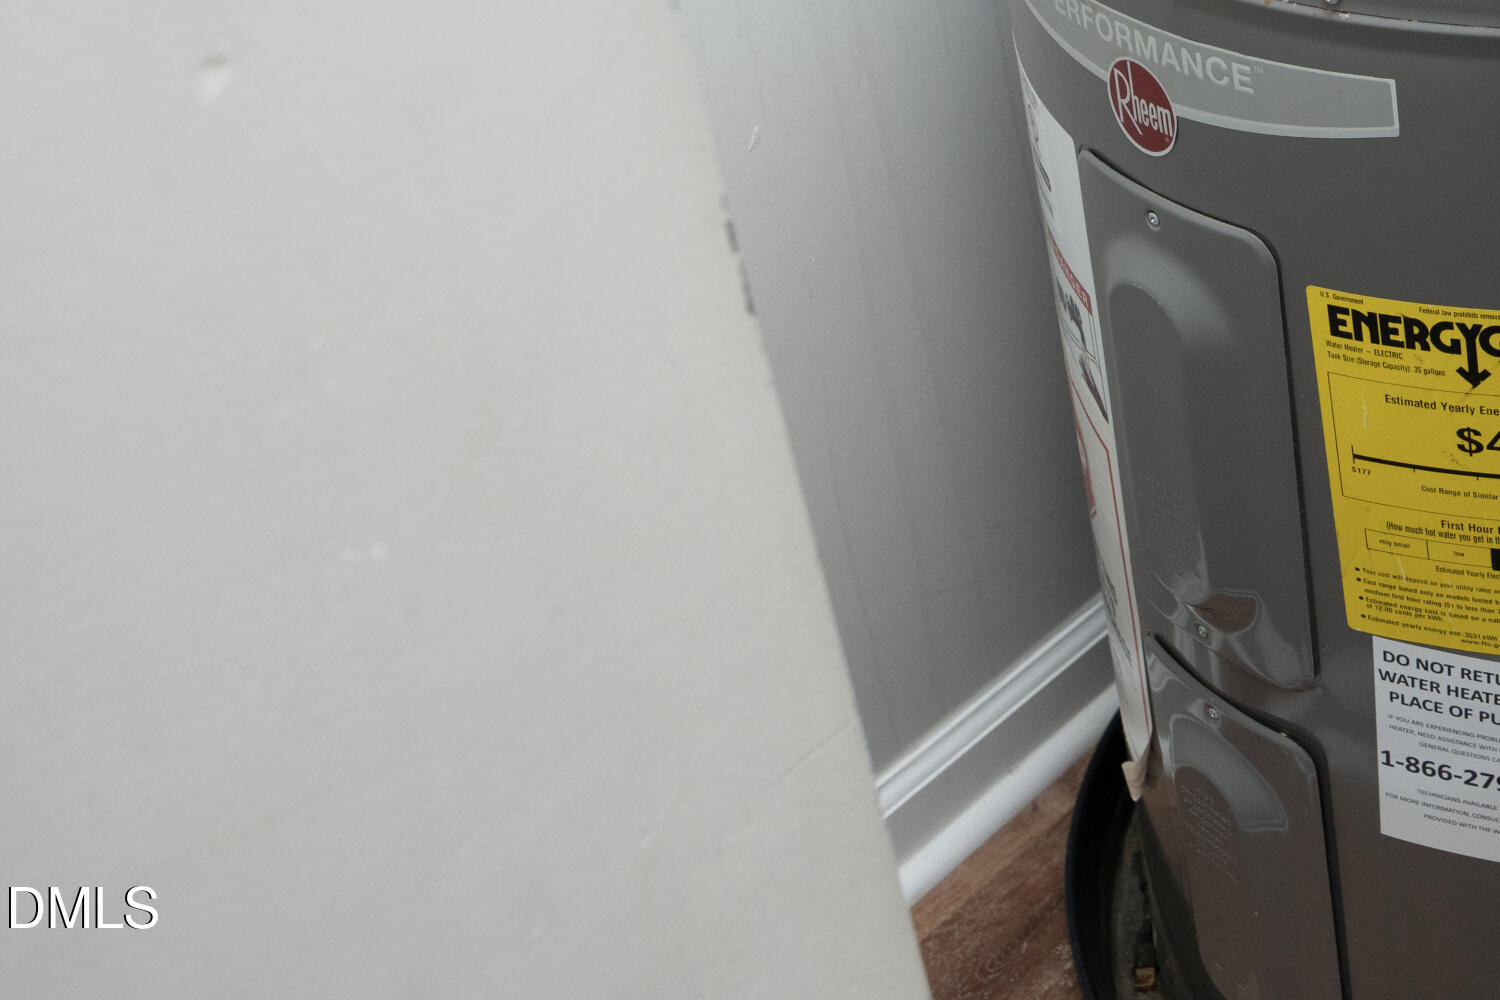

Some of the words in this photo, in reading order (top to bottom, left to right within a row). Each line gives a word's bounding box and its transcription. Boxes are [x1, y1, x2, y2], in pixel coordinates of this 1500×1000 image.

[1113, 60, 1173, 137] Rheem
[1326, 340, 1343, 349] Water
[1345, 344, 1363, 354] Heater
[1374, 349, 1404, 359] ELECTRIC
[1328, 351, 1341, 361] Tank
[1343, 354, 1354, 363] Size
[1356, 357, 1380, 368] (Storage
[1424, 368, 1446, 377] gallons
[1385, 394, 1436, 410] Estimated
[1441, 402, 1475, 416] Yearly
[1421, 485, 1436, 493] Cost
[1439, 488, 1461, 497] Range
[1473, 492, 1498, 500] Similar
[1387, 521, 1403, 532] (How
[1405, 526, 1423, 535] much
[1426, 528, 1436, 537] hot
[1438, 531, 1457, 540] water
[1459, 535, 1471, 544] you
[1474, 536, 1484, 544] get
[1441, 520, 1464, 531] First
[1469, 524, 1493, 534] Hour
[1436, 566, 1464, 576] Estimated
[1466, 571, 1485, 580] Yearly
[1382, 650, 1410, 667] DO
[1416, 658, 1455, 677] NOT
[1378, 668, 1441, 694] WATER
[1389, 691, 1443, 714] PLACE
[1449, 705, 1474, 720] OF
[1418, 732, 1436, 740] NEED
[1437, 736, 1477, 749] ASSISTANCE
[1426, 724, 1475, 738] EXPERIENCING
[1419, 742, 1450, 753] GENERAL
[1452, 749, 1490, 761] QUESTIONS
[1400, 796, 1420, 806] MORE
[1417, 789, 1461, 803] TECHNICIANS
[1462, 799, 1497, 811] AVAILABLE
[1424, 814, 1457, 826] PROVIDED
[1459, 822, 1477, 830] WITH
